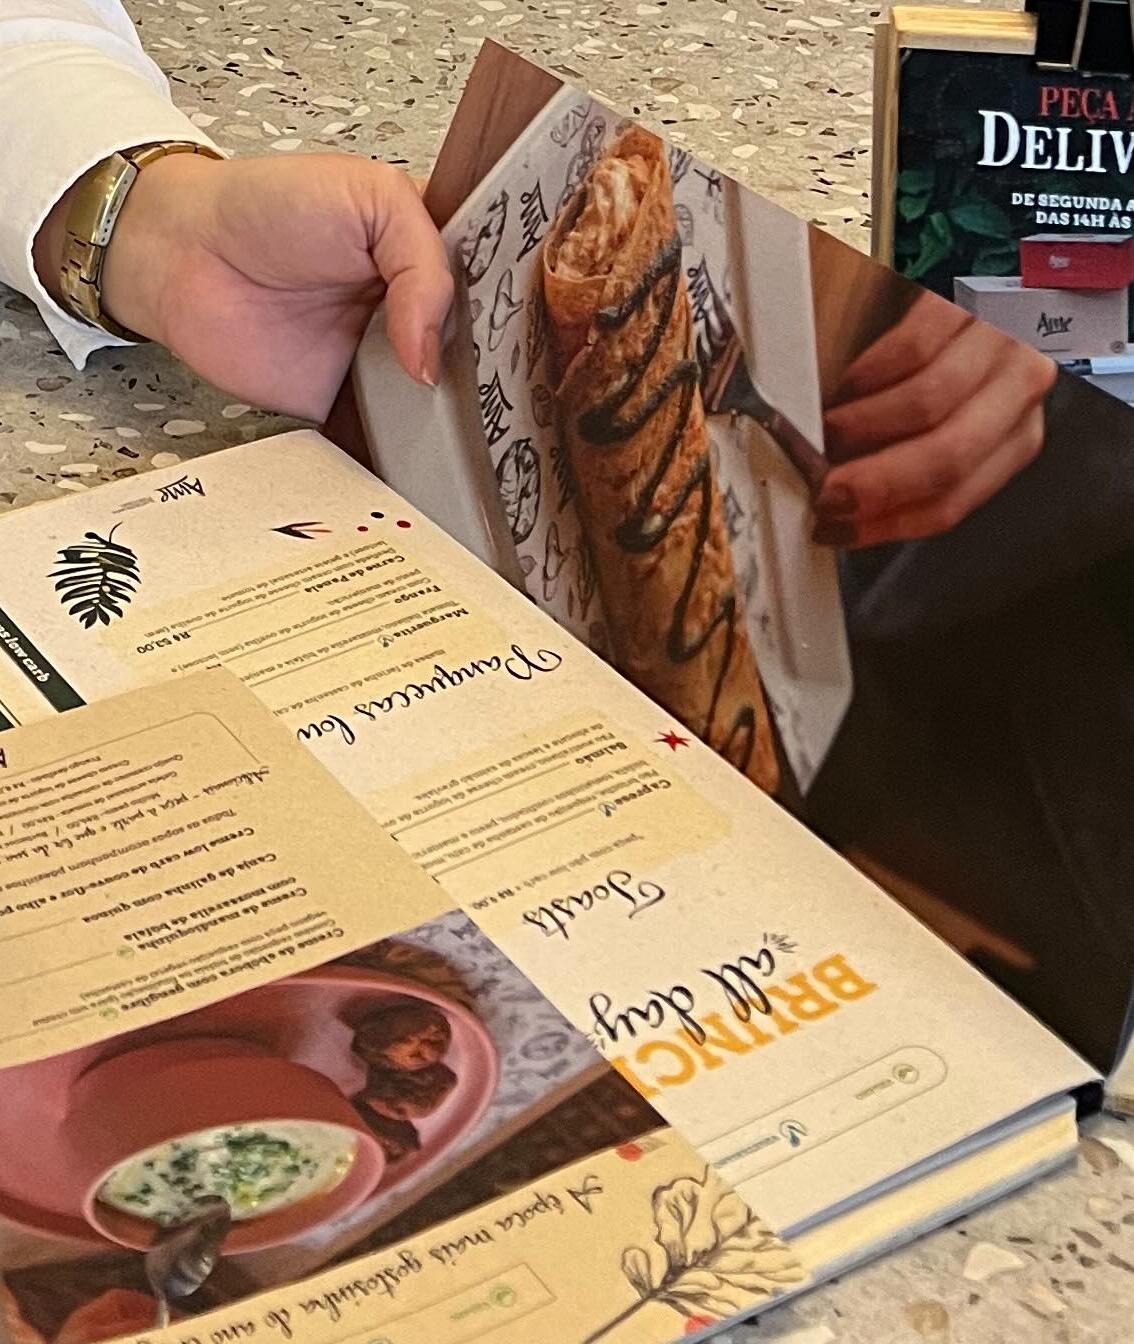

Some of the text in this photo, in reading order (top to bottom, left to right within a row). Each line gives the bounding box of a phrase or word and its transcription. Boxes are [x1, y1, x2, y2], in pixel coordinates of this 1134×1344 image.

[1039, 86, 1120, 124] PEÇA
[977, 110, 1134, 174] DELIV
[1011, 193, 1035, 206] DE
[1038, 194, 1122, 211] SEGUNDA
[1036, 211, 1070, 226] DAS
[1073, 214, 1105, 228] 14H
[347, 568, 364, 577] de
[364, 554, 405, 571] Carne
[303, 574, 350, 593] Panela
[393, 584, 441, 604] Frango
[392, 607, 469, 637] Marguerita
[171, 630, 191, 642] R$
[3, 633, 29, 659] low
[21, 657, 50, 682] carb
[295, 643, 562, 745] Panquecas low
[613, 778, 671, 805] Caprese
[208, 826, 254, 847] Creme
[182, 843, 210, 857] low
[130, 864, 148, 874] de
[148, 853, 180, 869] carb
[235, 852, 277, 870] Canja
[217, 866, 235, 877] de
[59, 871, 129, 898] couve-flor
[163, 871, 216, 896] galinha
[266, 876, 296, 891] com
[15, 897, 46, 910] alho
[131, 892, 162, 907] com
[260, 886, 307, 907] Creme
[521, 869, 665, 939] Toasts
[81, 901, 131, 923] quinoa
[240, 904, 259, 914] de
[169, 915, 188, 925] de
[122, 921, 171, 941] búfala
[296, 927, 344, 949] Creme
[277, 945, 295, 956] de
[185, 973, 218, 988] com
[120, 981, 185, 1011] gengibre
[588, 948, 776, 1046] all day
[565, 1173, 603, 1214] A
[495, 1191, 564, 1231] época
[428, 1228, 492, 1266] mais
[297, 1248, 422, 1323] gostosinha
